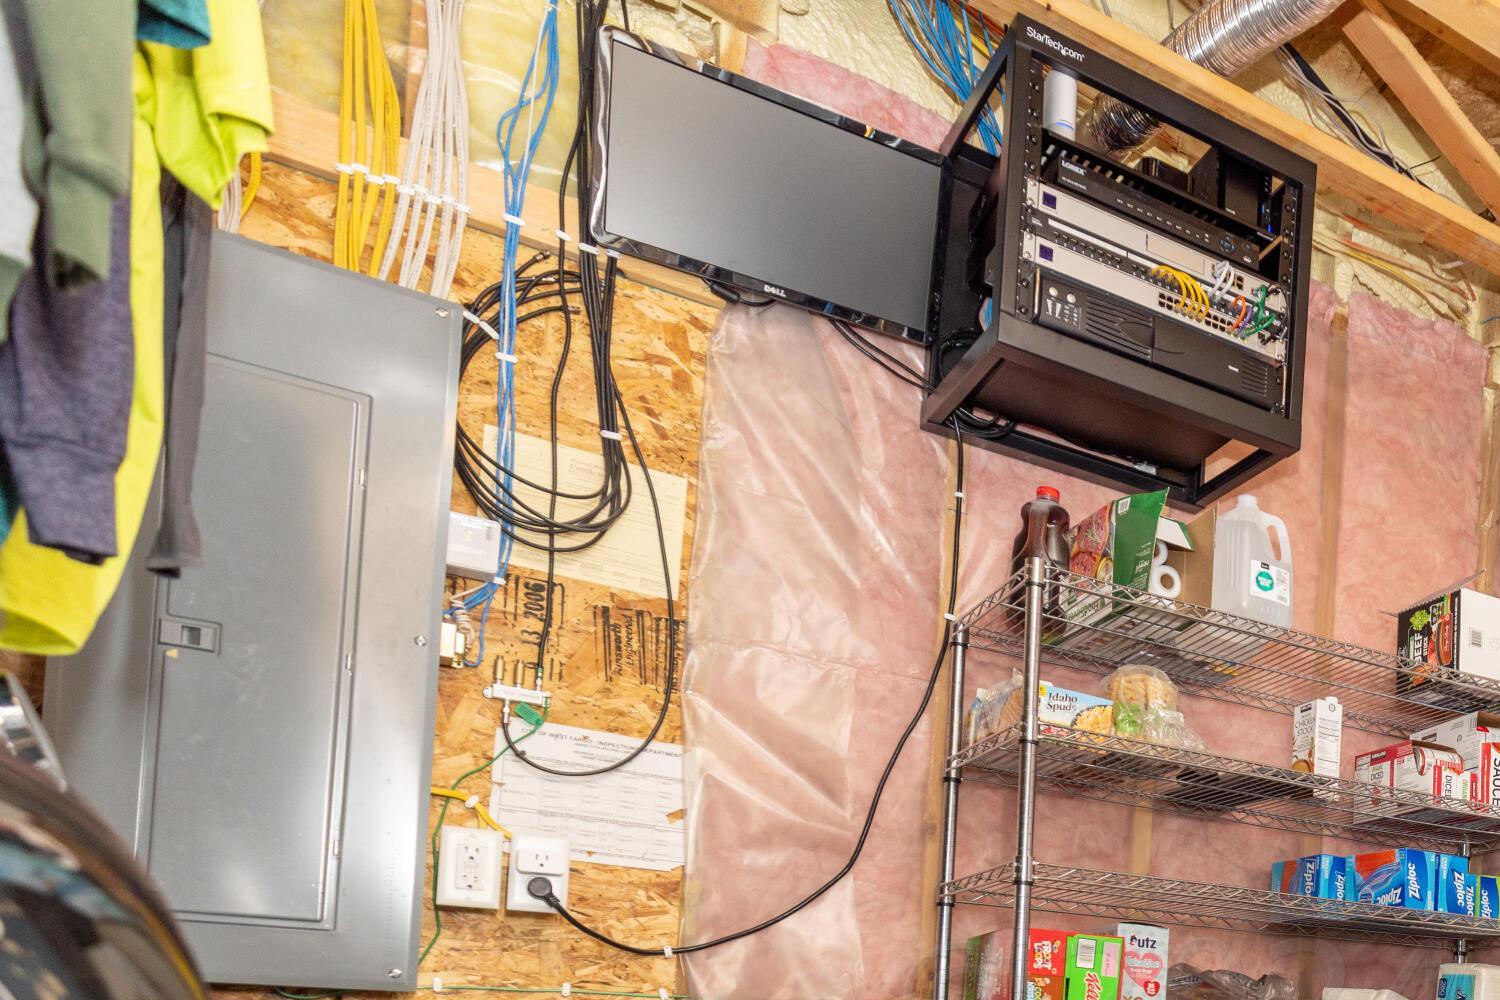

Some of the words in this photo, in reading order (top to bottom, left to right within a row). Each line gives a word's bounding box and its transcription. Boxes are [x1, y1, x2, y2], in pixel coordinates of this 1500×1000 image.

[1026, 26, 1084, 62] StarTech.com
[763, 284, 786, 298] DELL
[523, 581, 545, 622] 2006
[1048, 692, 1078, 702] Idaho
[1408, 862, 1420, 900] Ziploc
[1453, 871, 1465, 908] Ziploc
[1465, 884, 1474, 916] Ziploc
[1033, 943, 1042, 969] LOOPS
[1042, 940, 1052, 971] FROOT
